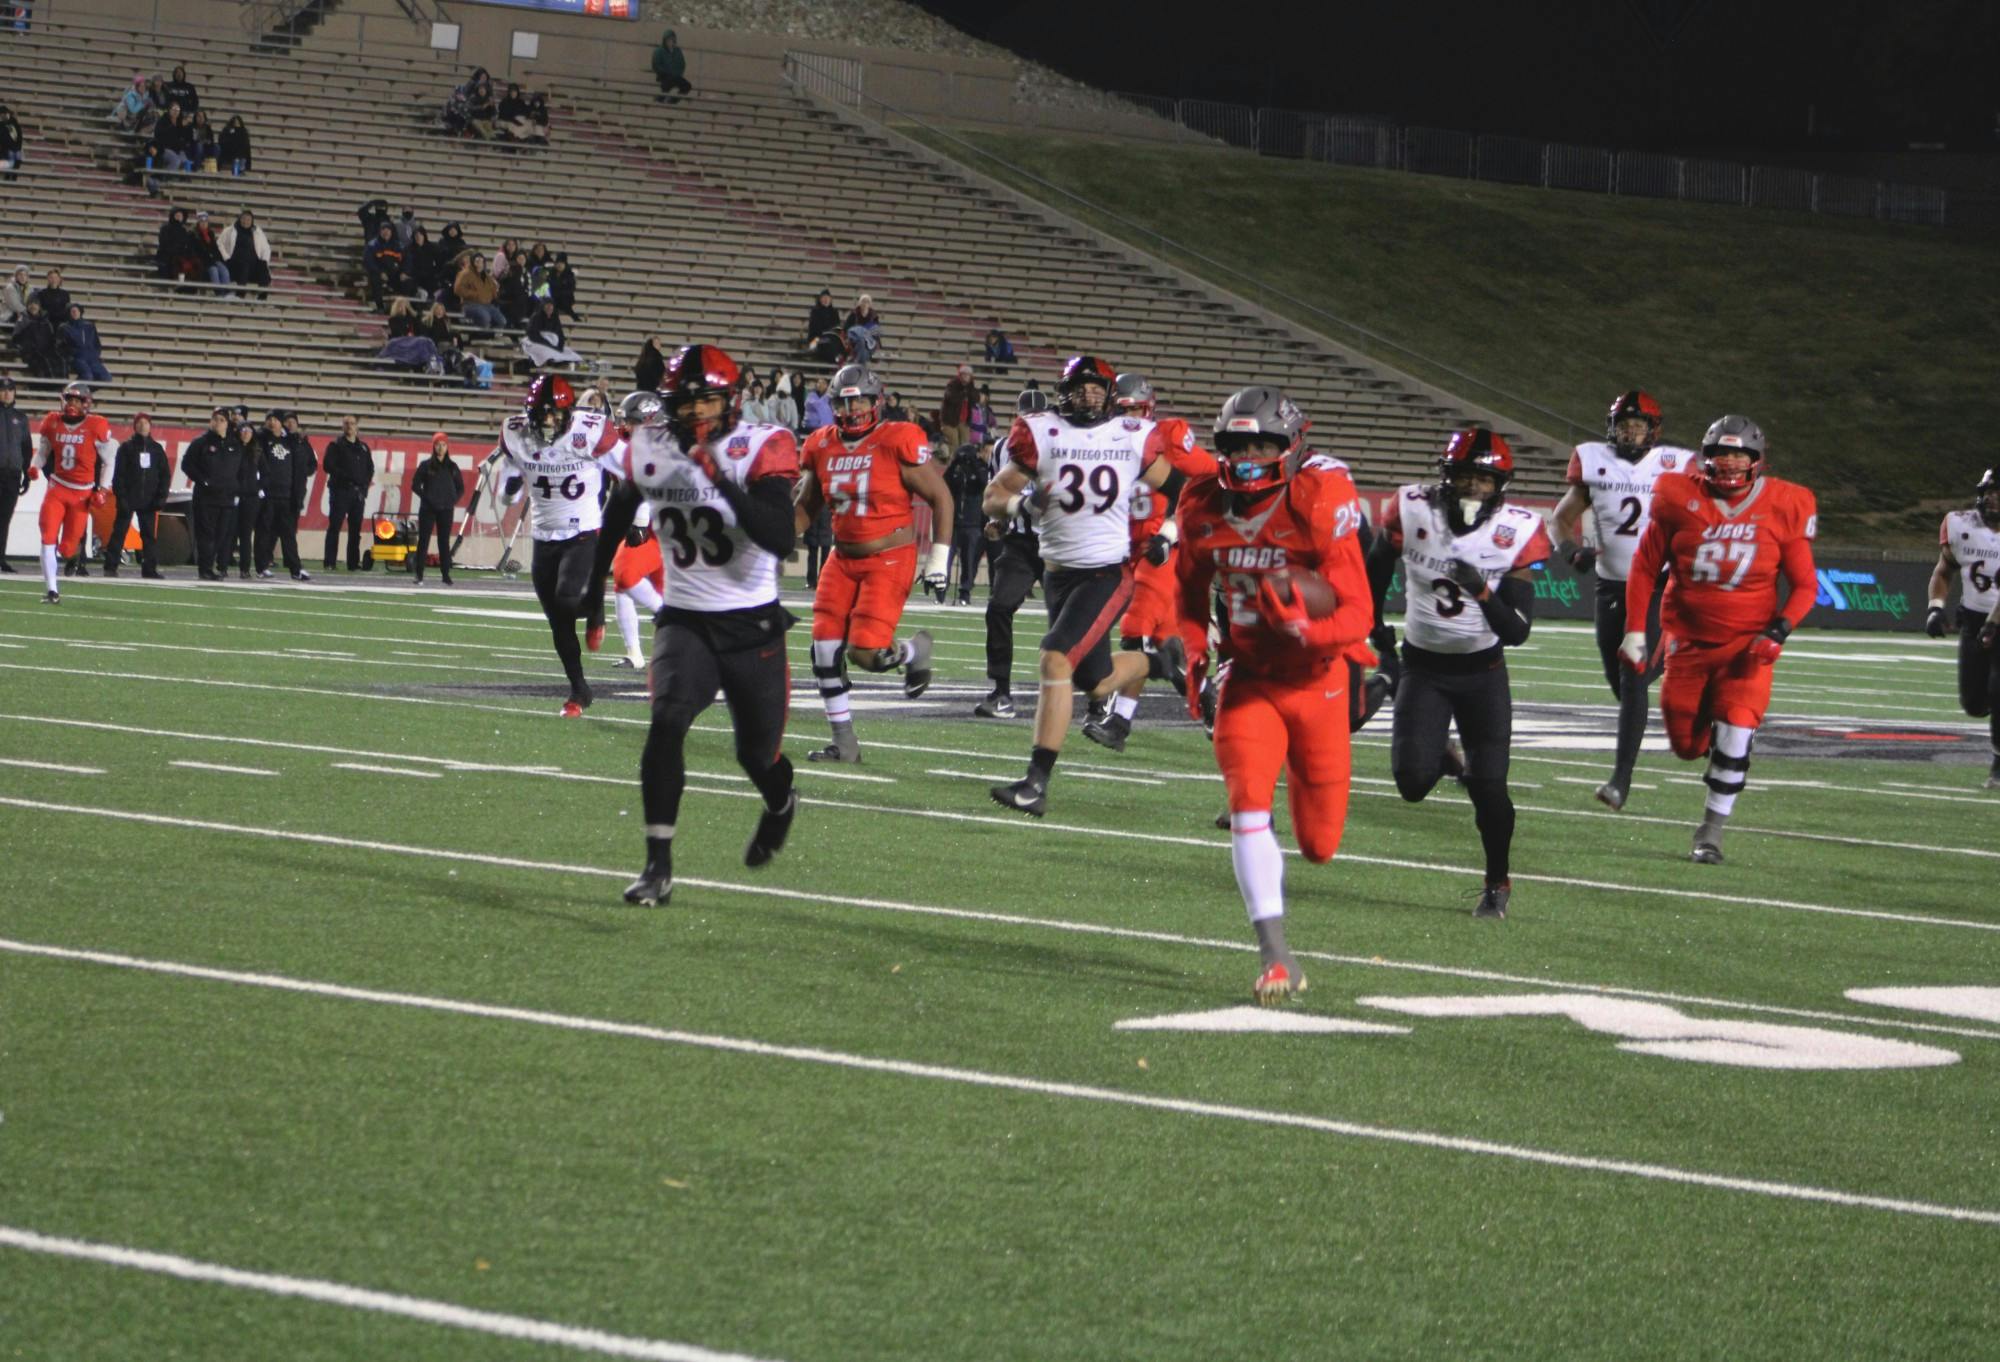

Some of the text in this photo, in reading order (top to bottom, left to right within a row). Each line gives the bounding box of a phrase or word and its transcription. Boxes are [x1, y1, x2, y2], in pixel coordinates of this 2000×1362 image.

[55, 433, 85, 444] LOBOS
[524, 461, 584, 473] SAN DIEGO STATE
[827, 454, 873, 472] LOBOS
[916, 446, 931, 464] 5
[1050, 448, 1132, 461] SAN DIEGO STATE
[532, 474, 586, 501] 46
[646, 488, 664, 498] SAN
[667, 487, 700, 502] DIEGO
[829, 471, 870, 516] 51
[1059, 464, 1119, 514] 39
[1599, 481, 1613, 490] SAN
[1614, 481, 1640, 493] DIEGO
[1333, 500, 1361, 538] 25
[1615, 496, 1642, 536] 2
[659, 505, 734, 569] 33
[1212, 548, 1287, 568] LOBOS
[1408, 549, 1425, 565] SAN
[1427, 558, 1457, 576] DIE
[1691, 540, 1757, 591] 67
[1963, 546, 1999, 559] SAN DIEGO
[1970, 560, 2000, 593] 6
[1227, 572, 1259, 624] 2
[1432, 578, 1465, 618] 3
[1843, 582, 1910, 620] Market
